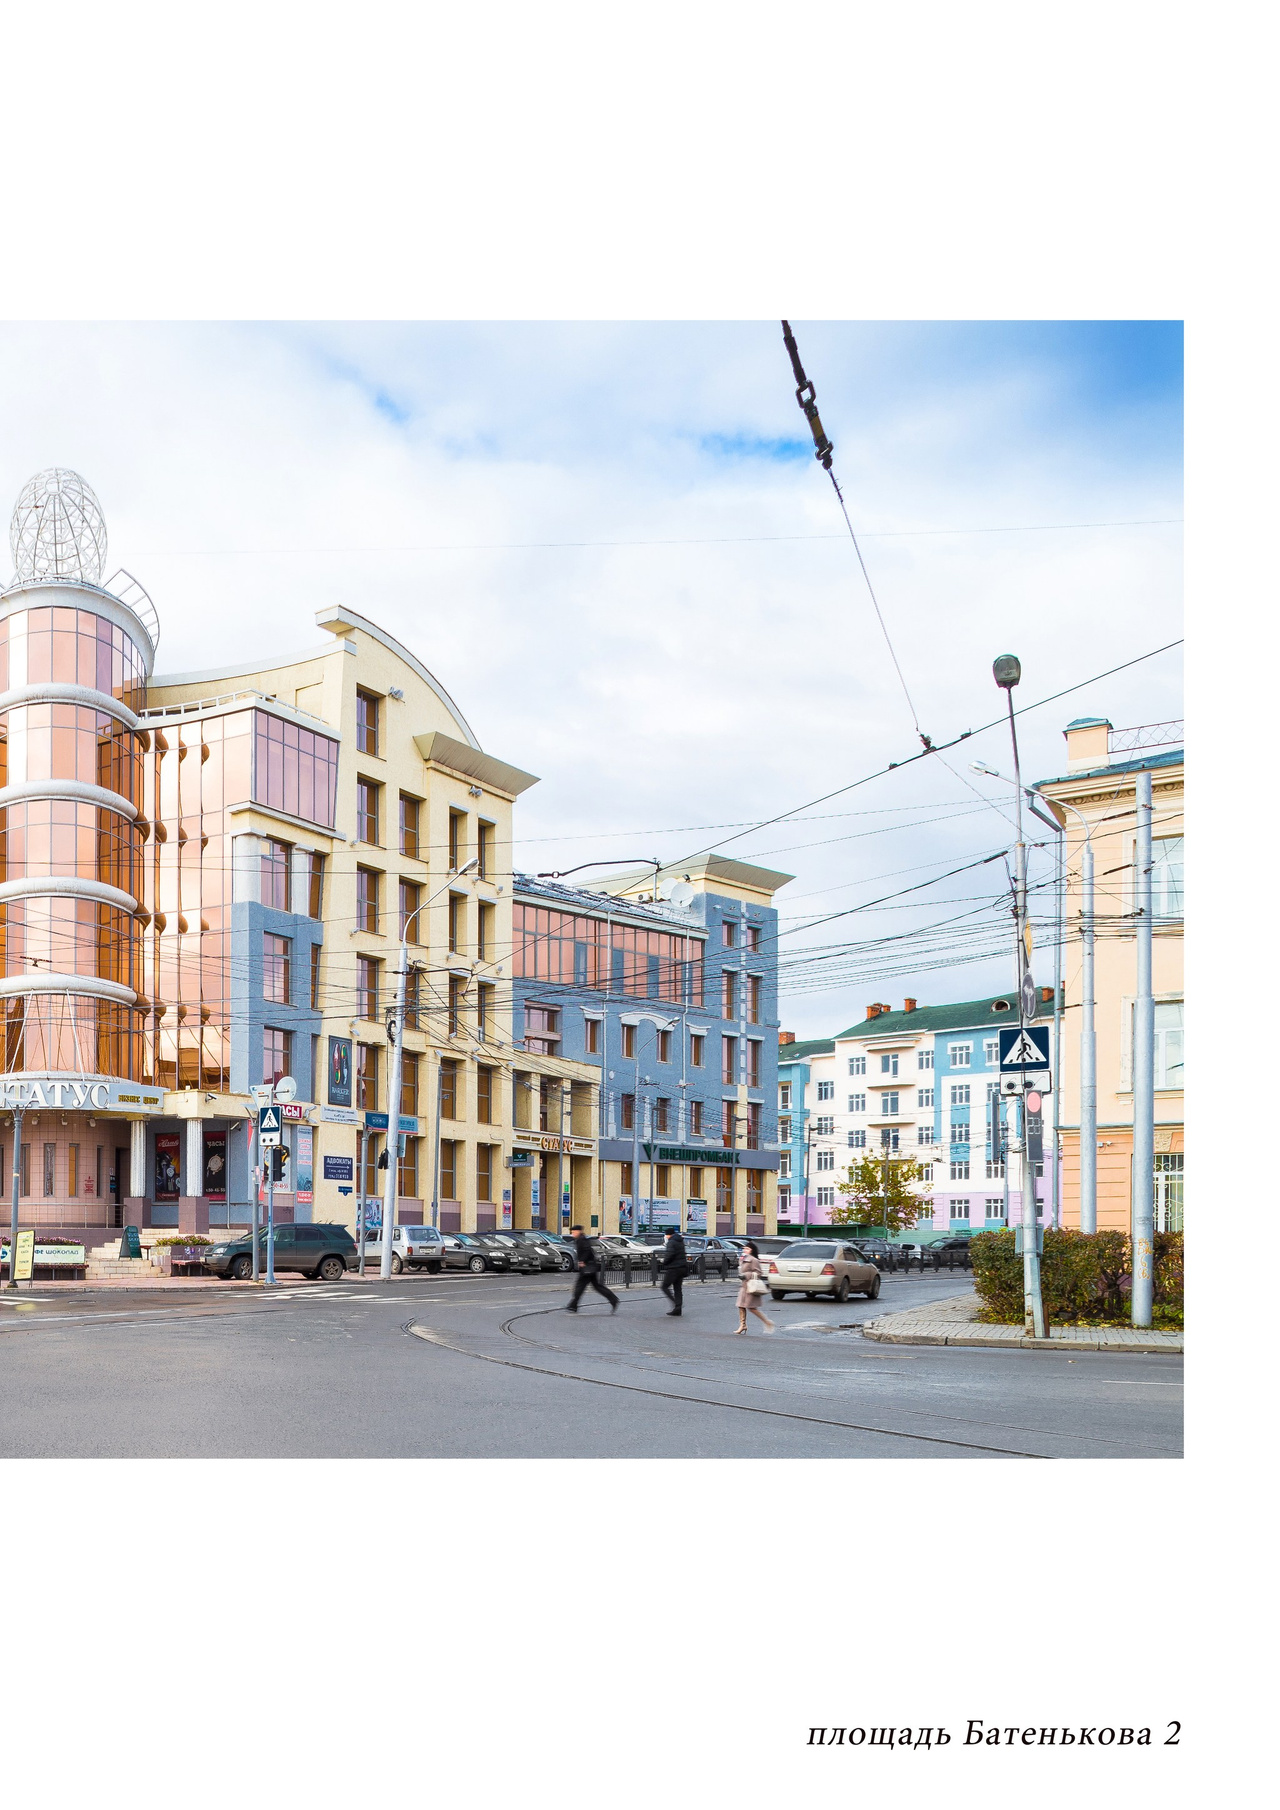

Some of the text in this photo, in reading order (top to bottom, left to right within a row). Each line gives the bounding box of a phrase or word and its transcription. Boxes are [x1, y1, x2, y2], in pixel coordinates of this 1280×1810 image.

[541, 1137, 573, 1152] СТАУС
[326, 1157, 351, 1165] АДВОКАТЫ
[659, 1148, 740, 1164] ВНЕШПРОМБАНК
